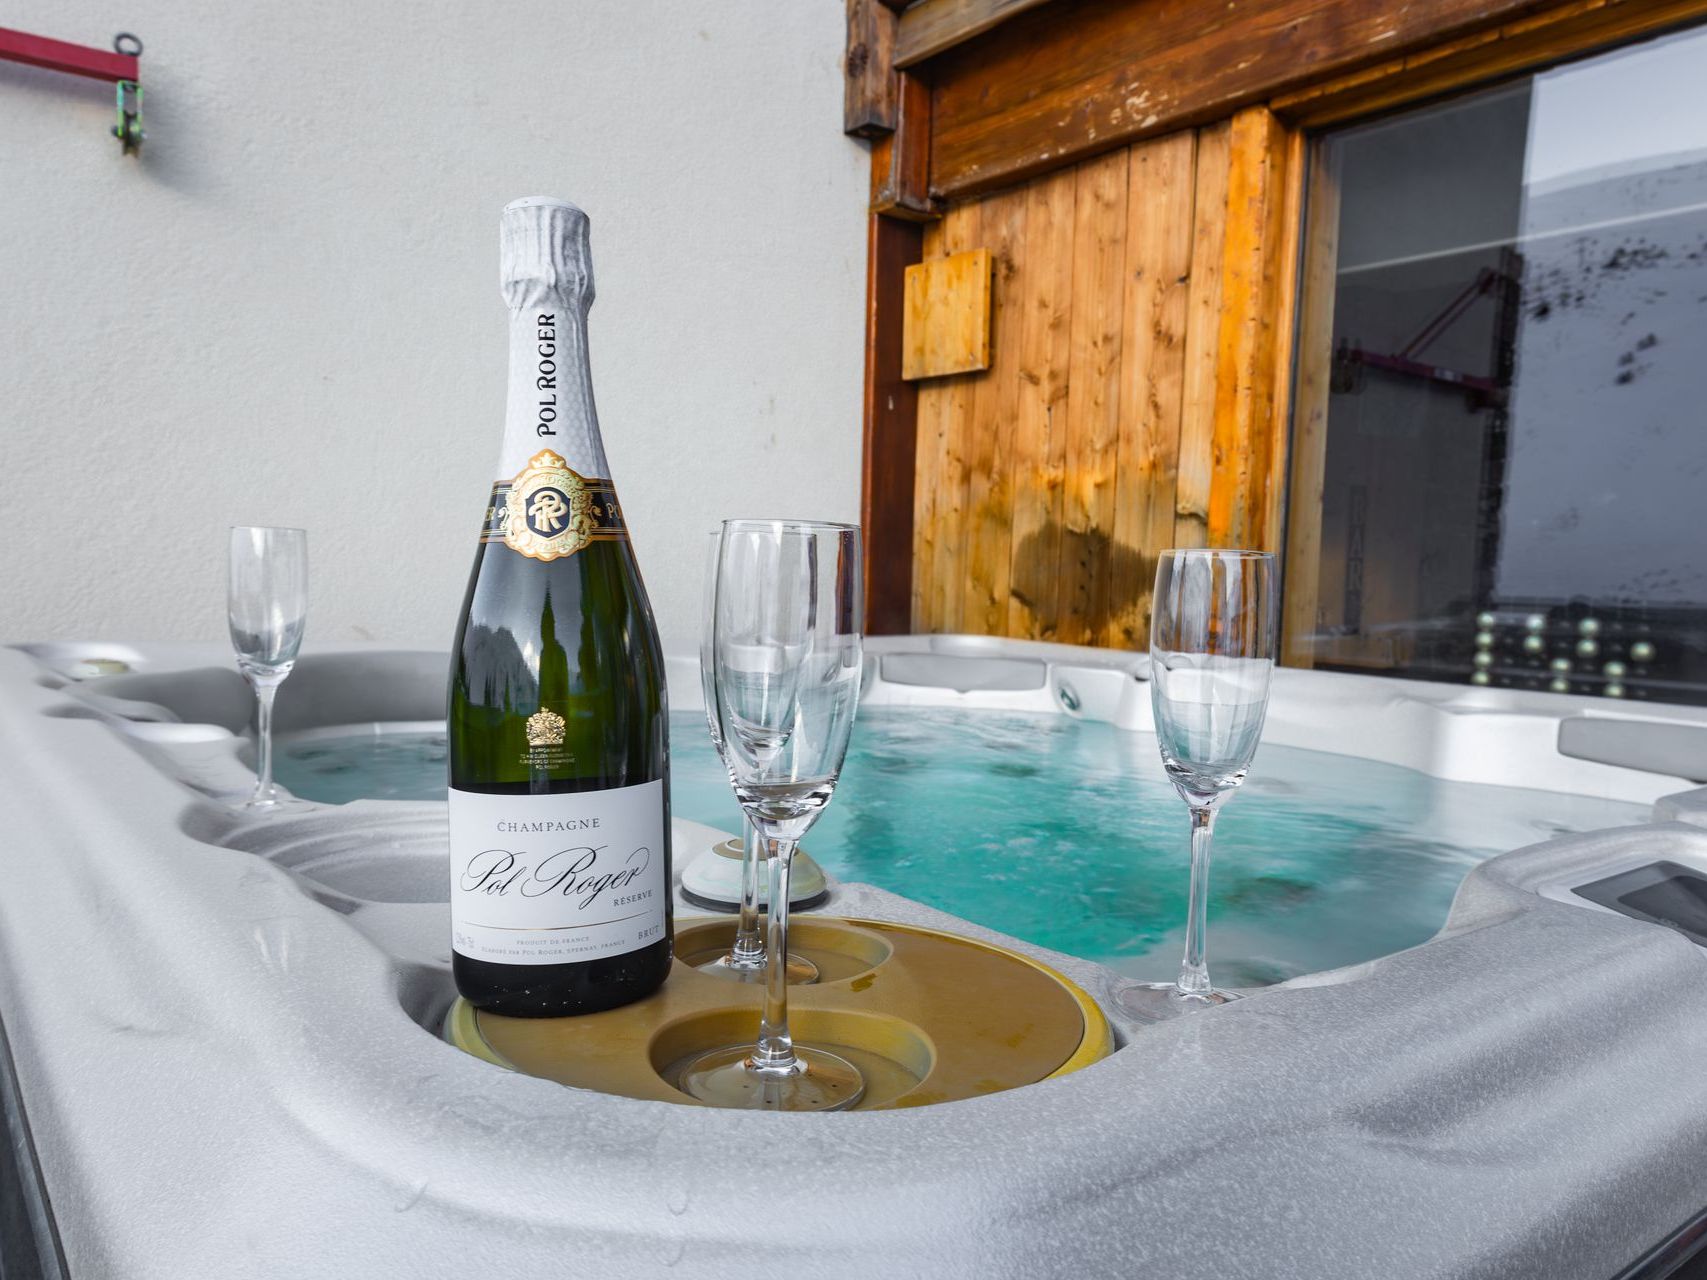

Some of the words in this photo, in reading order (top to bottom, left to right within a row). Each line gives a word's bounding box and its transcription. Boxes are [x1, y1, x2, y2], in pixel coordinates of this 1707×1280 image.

[537, 313, 556, 390] ROGER
[537, 394, 556, 438] POL
[497, 817, 600, 832] CHAMPAGNE
[460, 849, 527, 896] Pol
[521, 845, 650, 910] Roger
[638, 925, 660, 940] BRUT
